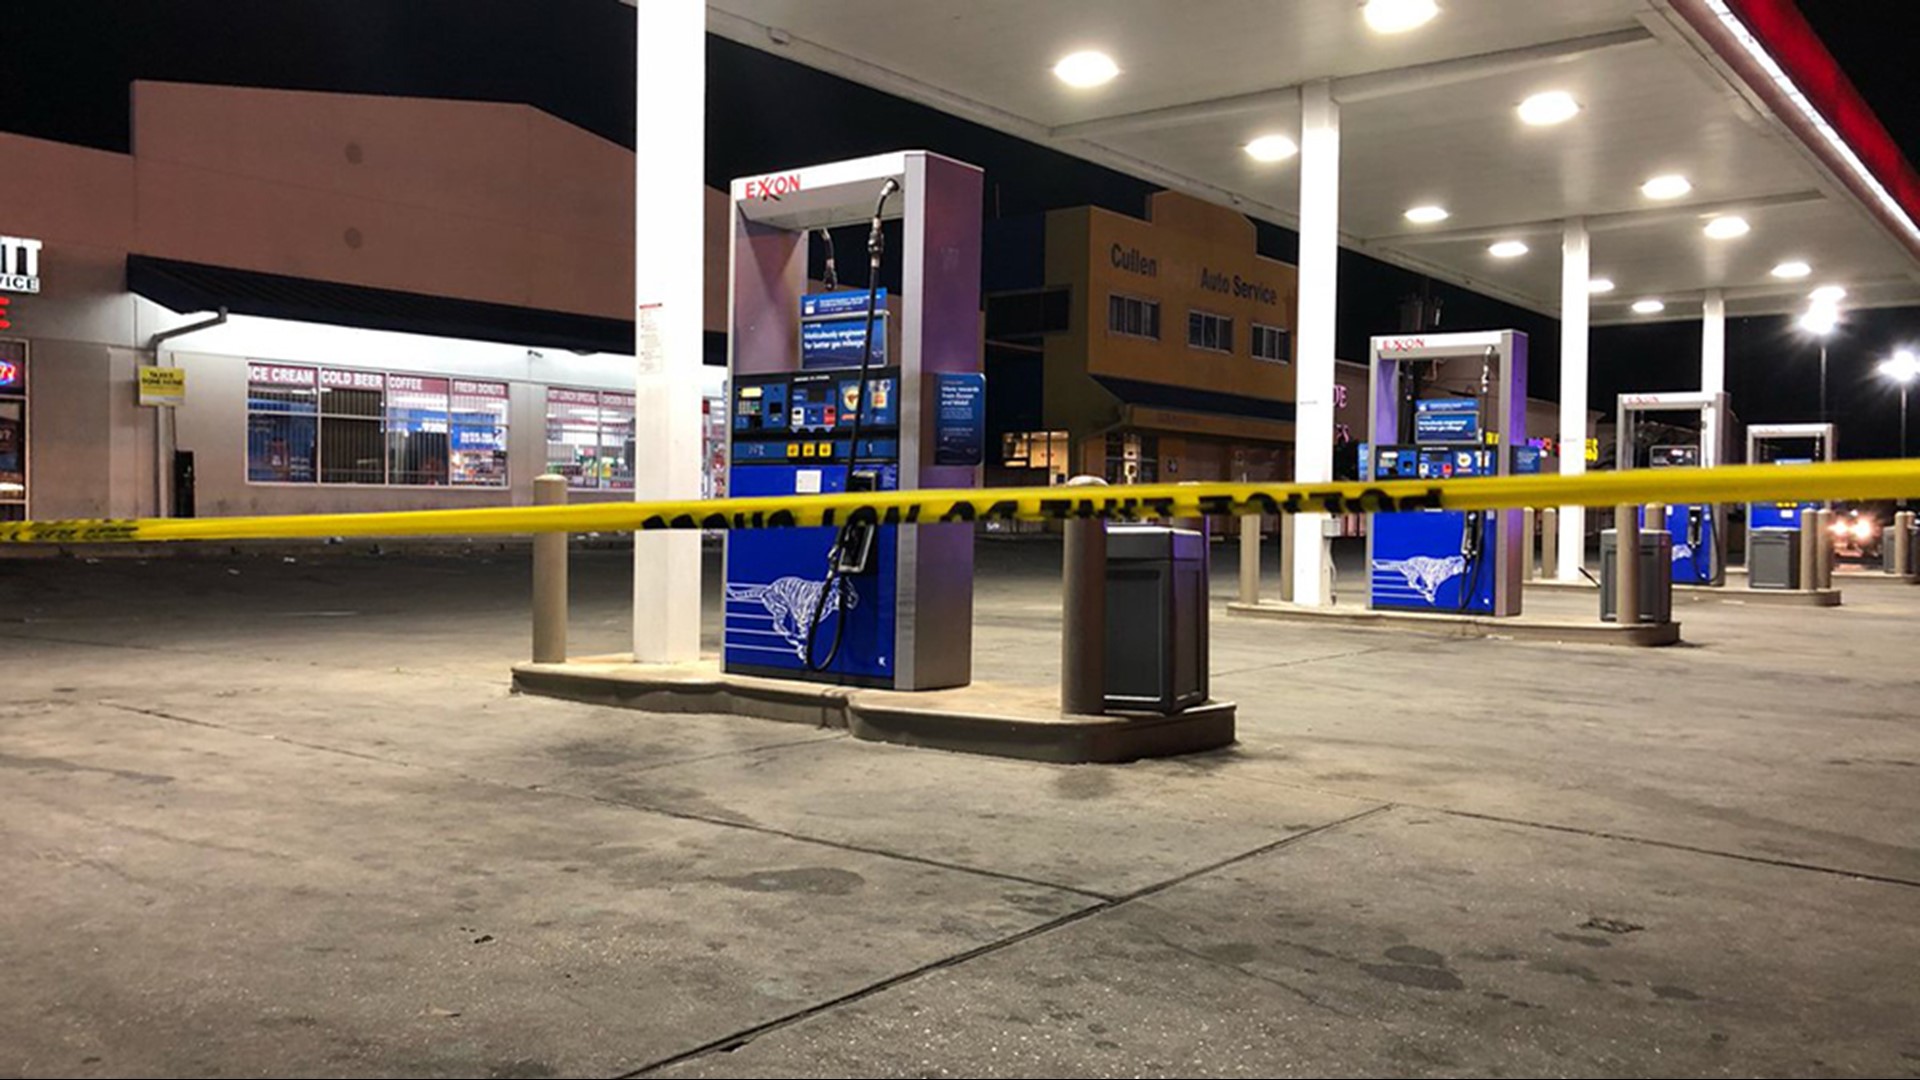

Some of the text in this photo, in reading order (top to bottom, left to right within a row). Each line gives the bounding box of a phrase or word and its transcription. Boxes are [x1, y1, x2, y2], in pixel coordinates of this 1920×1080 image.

[1110, 243, 1158, 277] Cullen
[1200, 267, 1278, 306] Auto Service
[270, 368, 314, 384] CREAM
[319, 371, 351, 385] COLD
[353, 374, 384, 387] BEER
[387, 378, 423, 392] COFFEE
